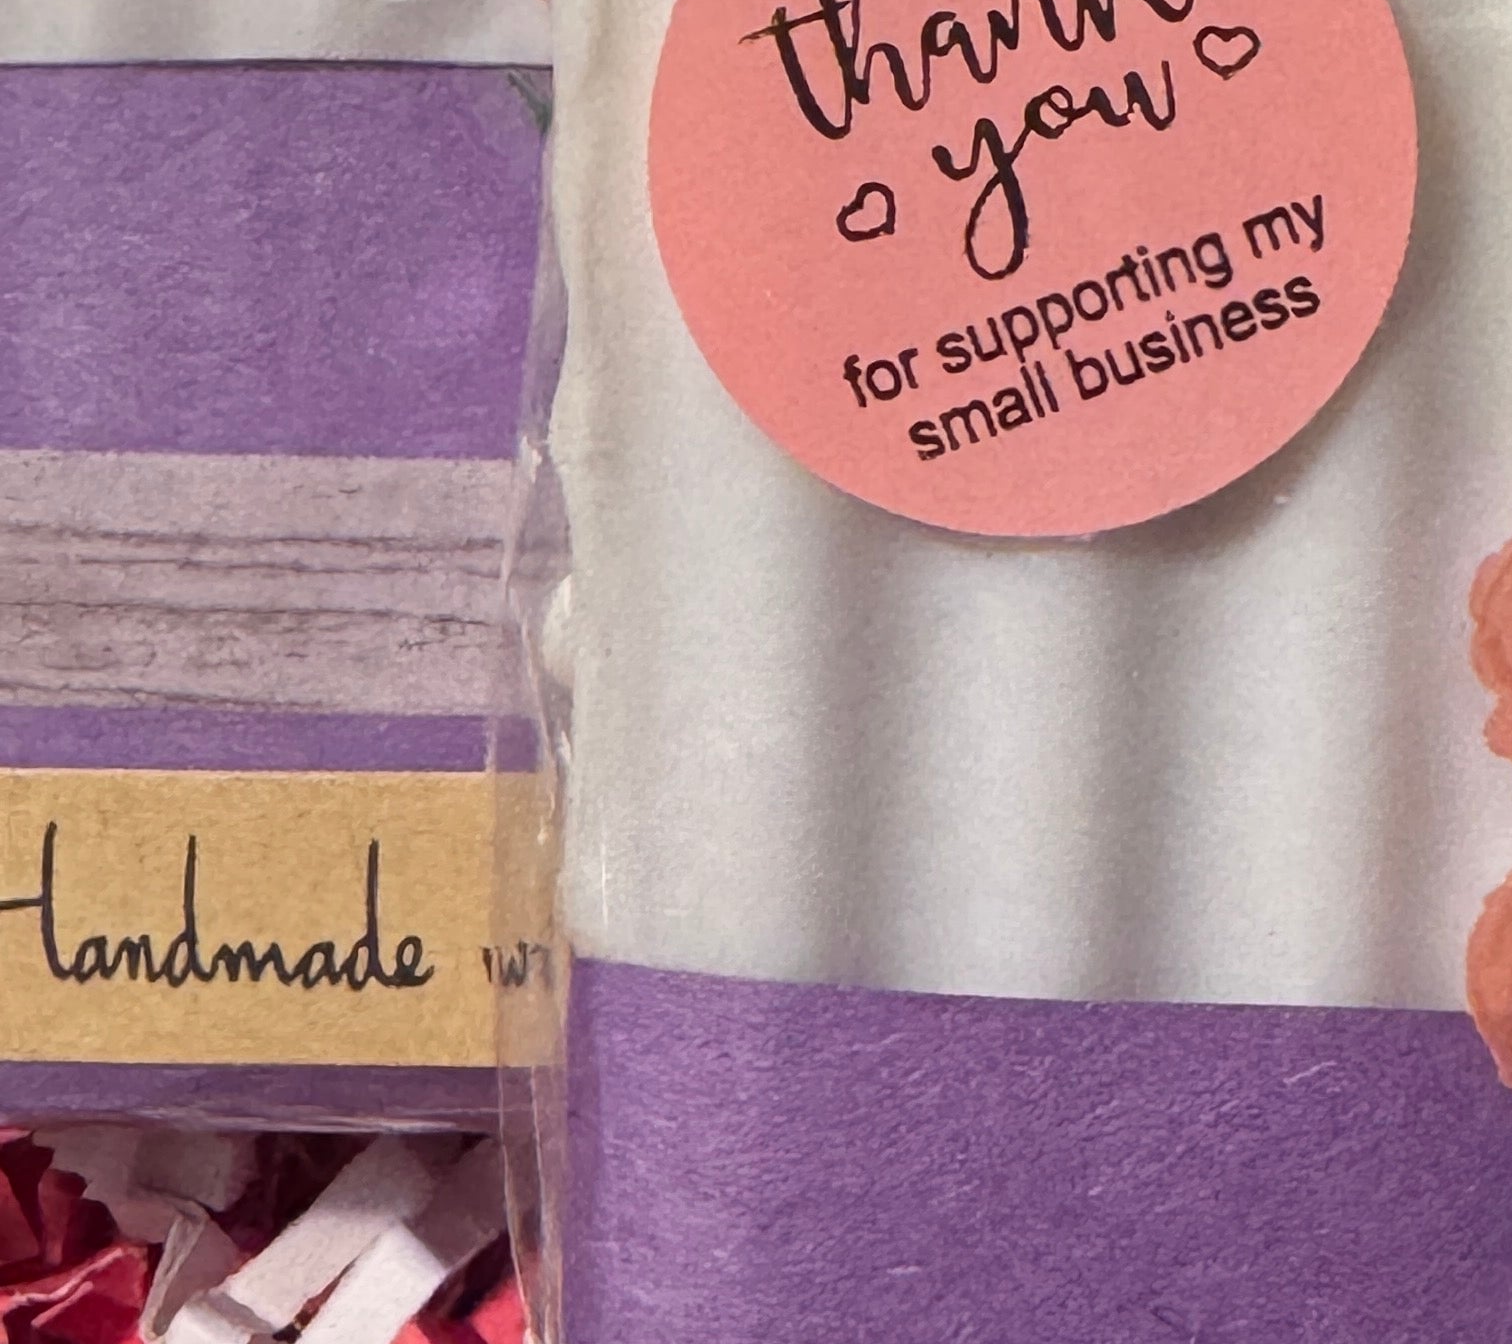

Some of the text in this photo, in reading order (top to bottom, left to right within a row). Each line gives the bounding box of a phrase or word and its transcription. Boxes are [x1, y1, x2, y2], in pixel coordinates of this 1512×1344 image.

[932, 60, 1177, 280] you
[843, 194, 1327, 408] for supporting my
[908, 275, 1322, 462] small business
